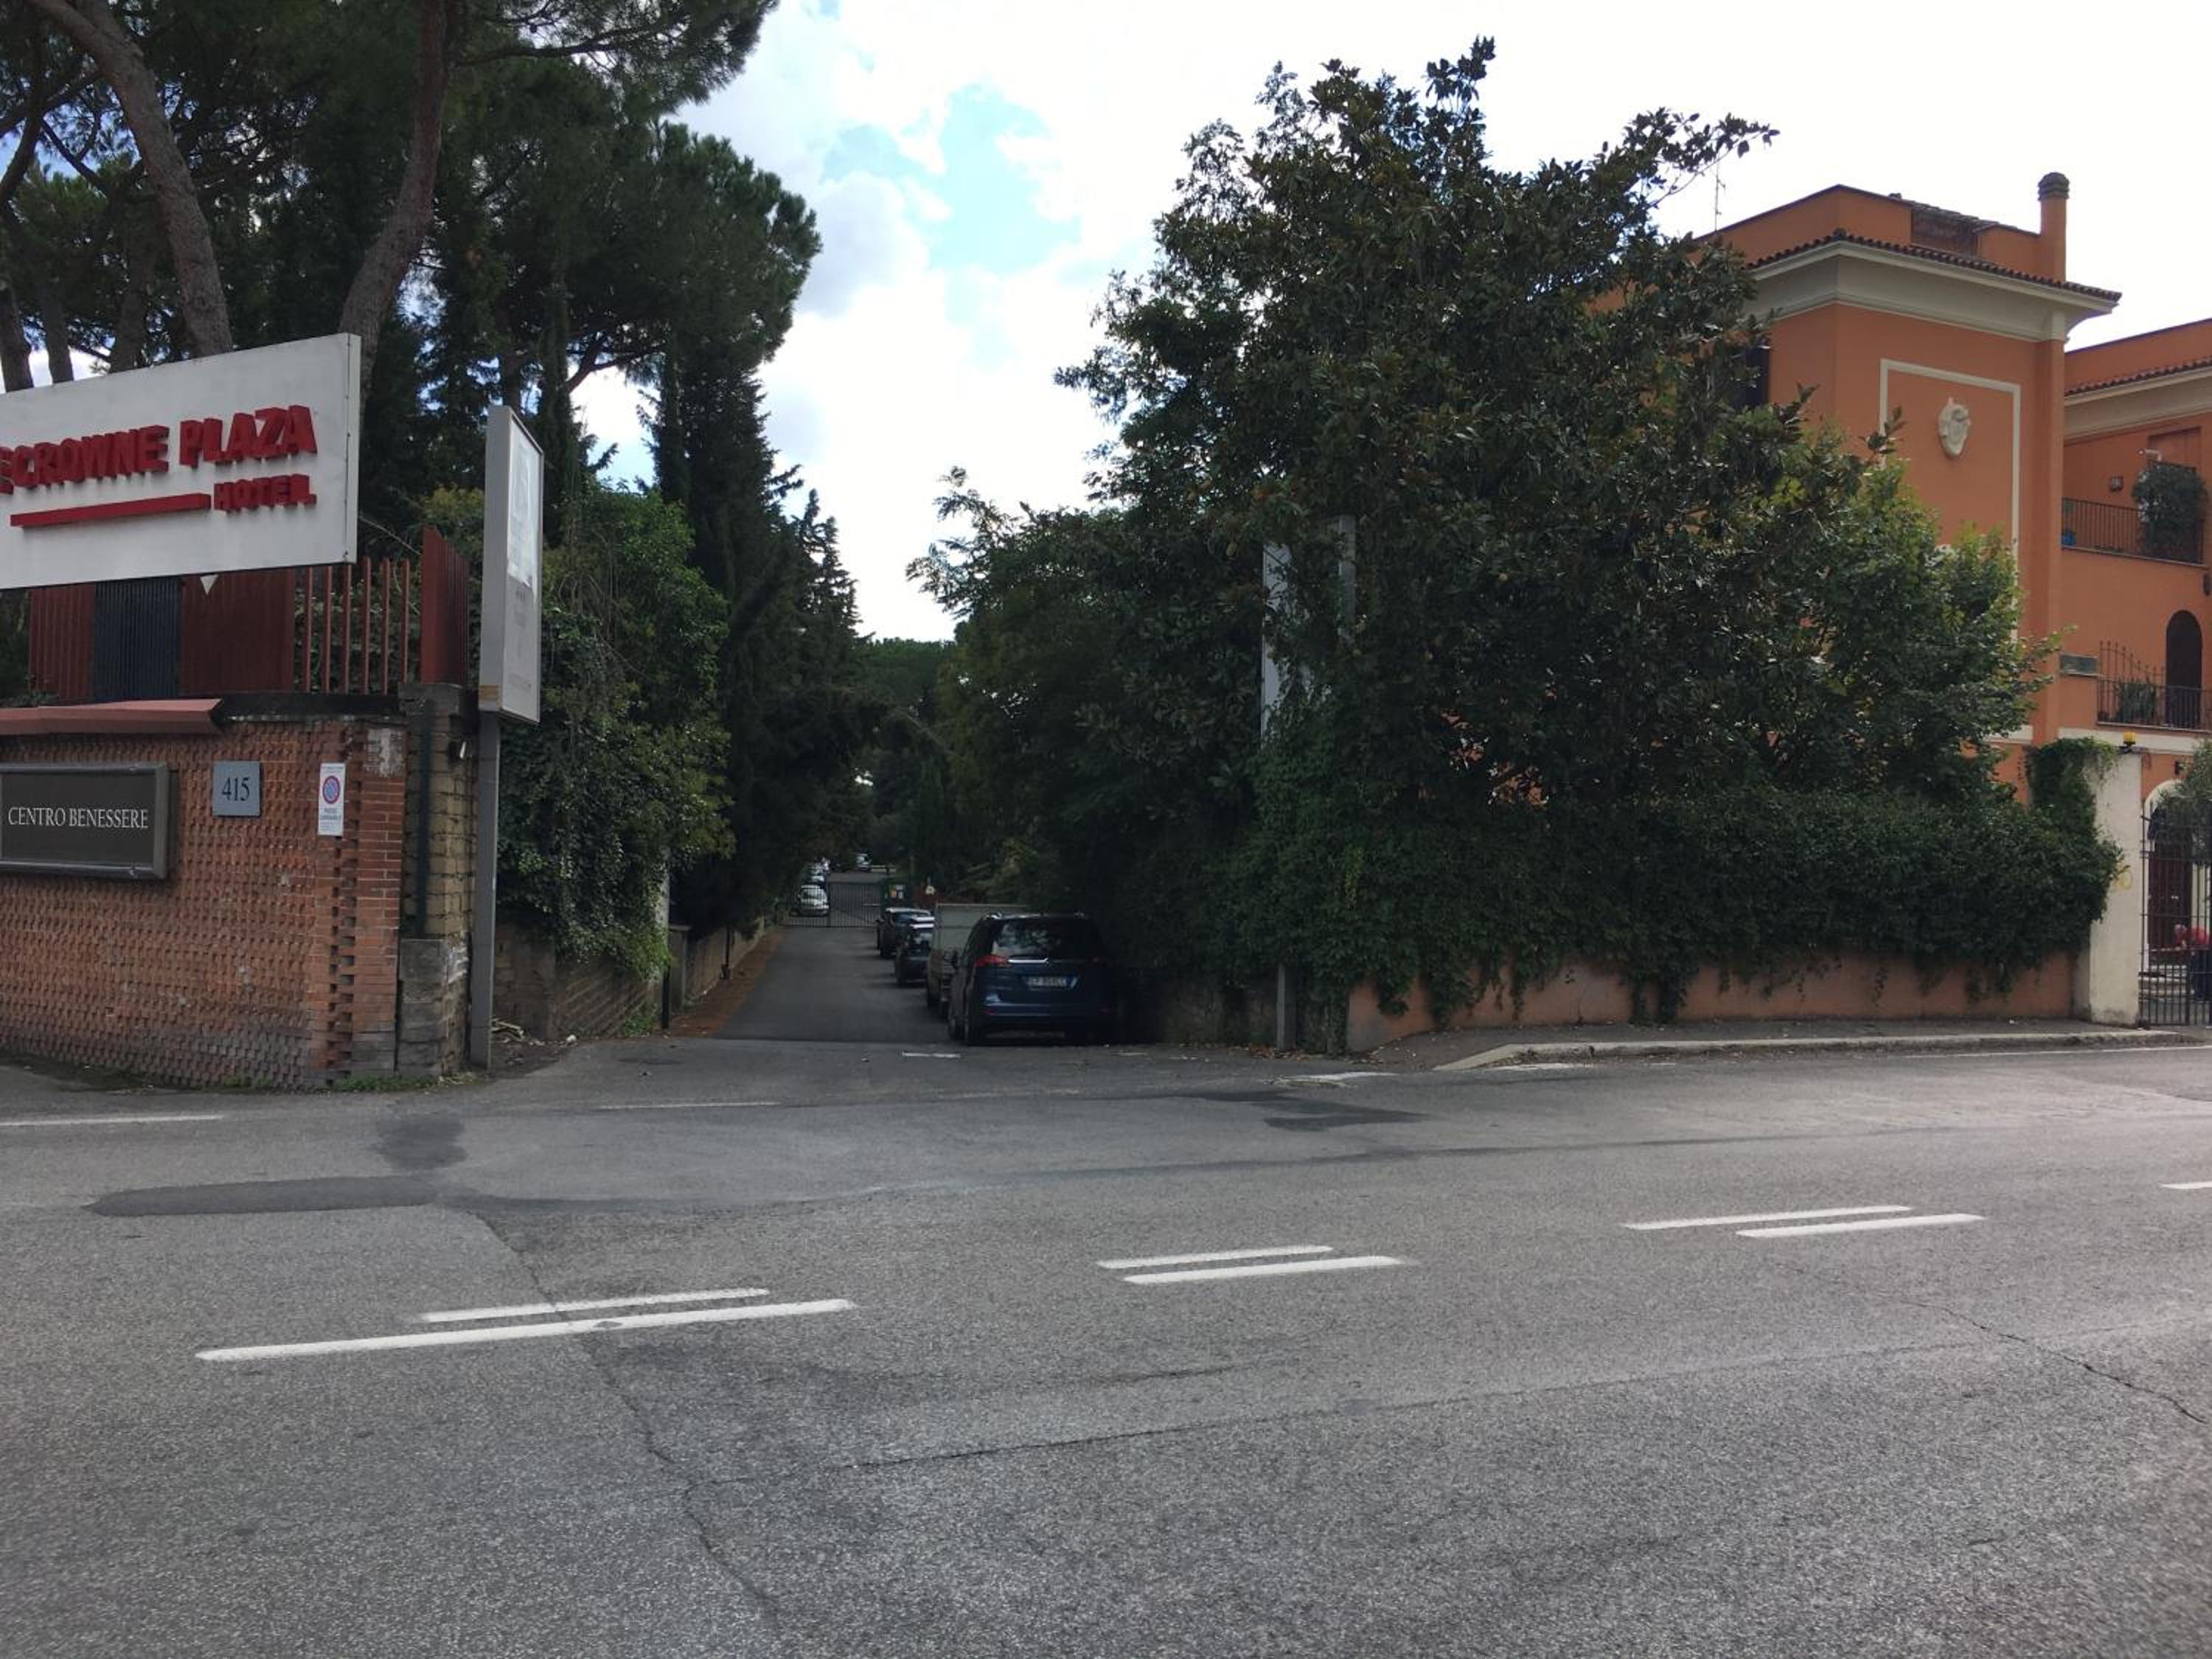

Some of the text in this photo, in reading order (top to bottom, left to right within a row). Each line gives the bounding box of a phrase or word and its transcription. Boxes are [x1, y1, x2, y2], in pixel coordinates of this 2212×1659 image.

[13, 404, 317, 490] CROWNE PLAZA
[214, 473, 317, 512] HOTEL
[222, 776, 250, 801] 415
[8, 807, 148, 829] CENTRO BENESSERE
